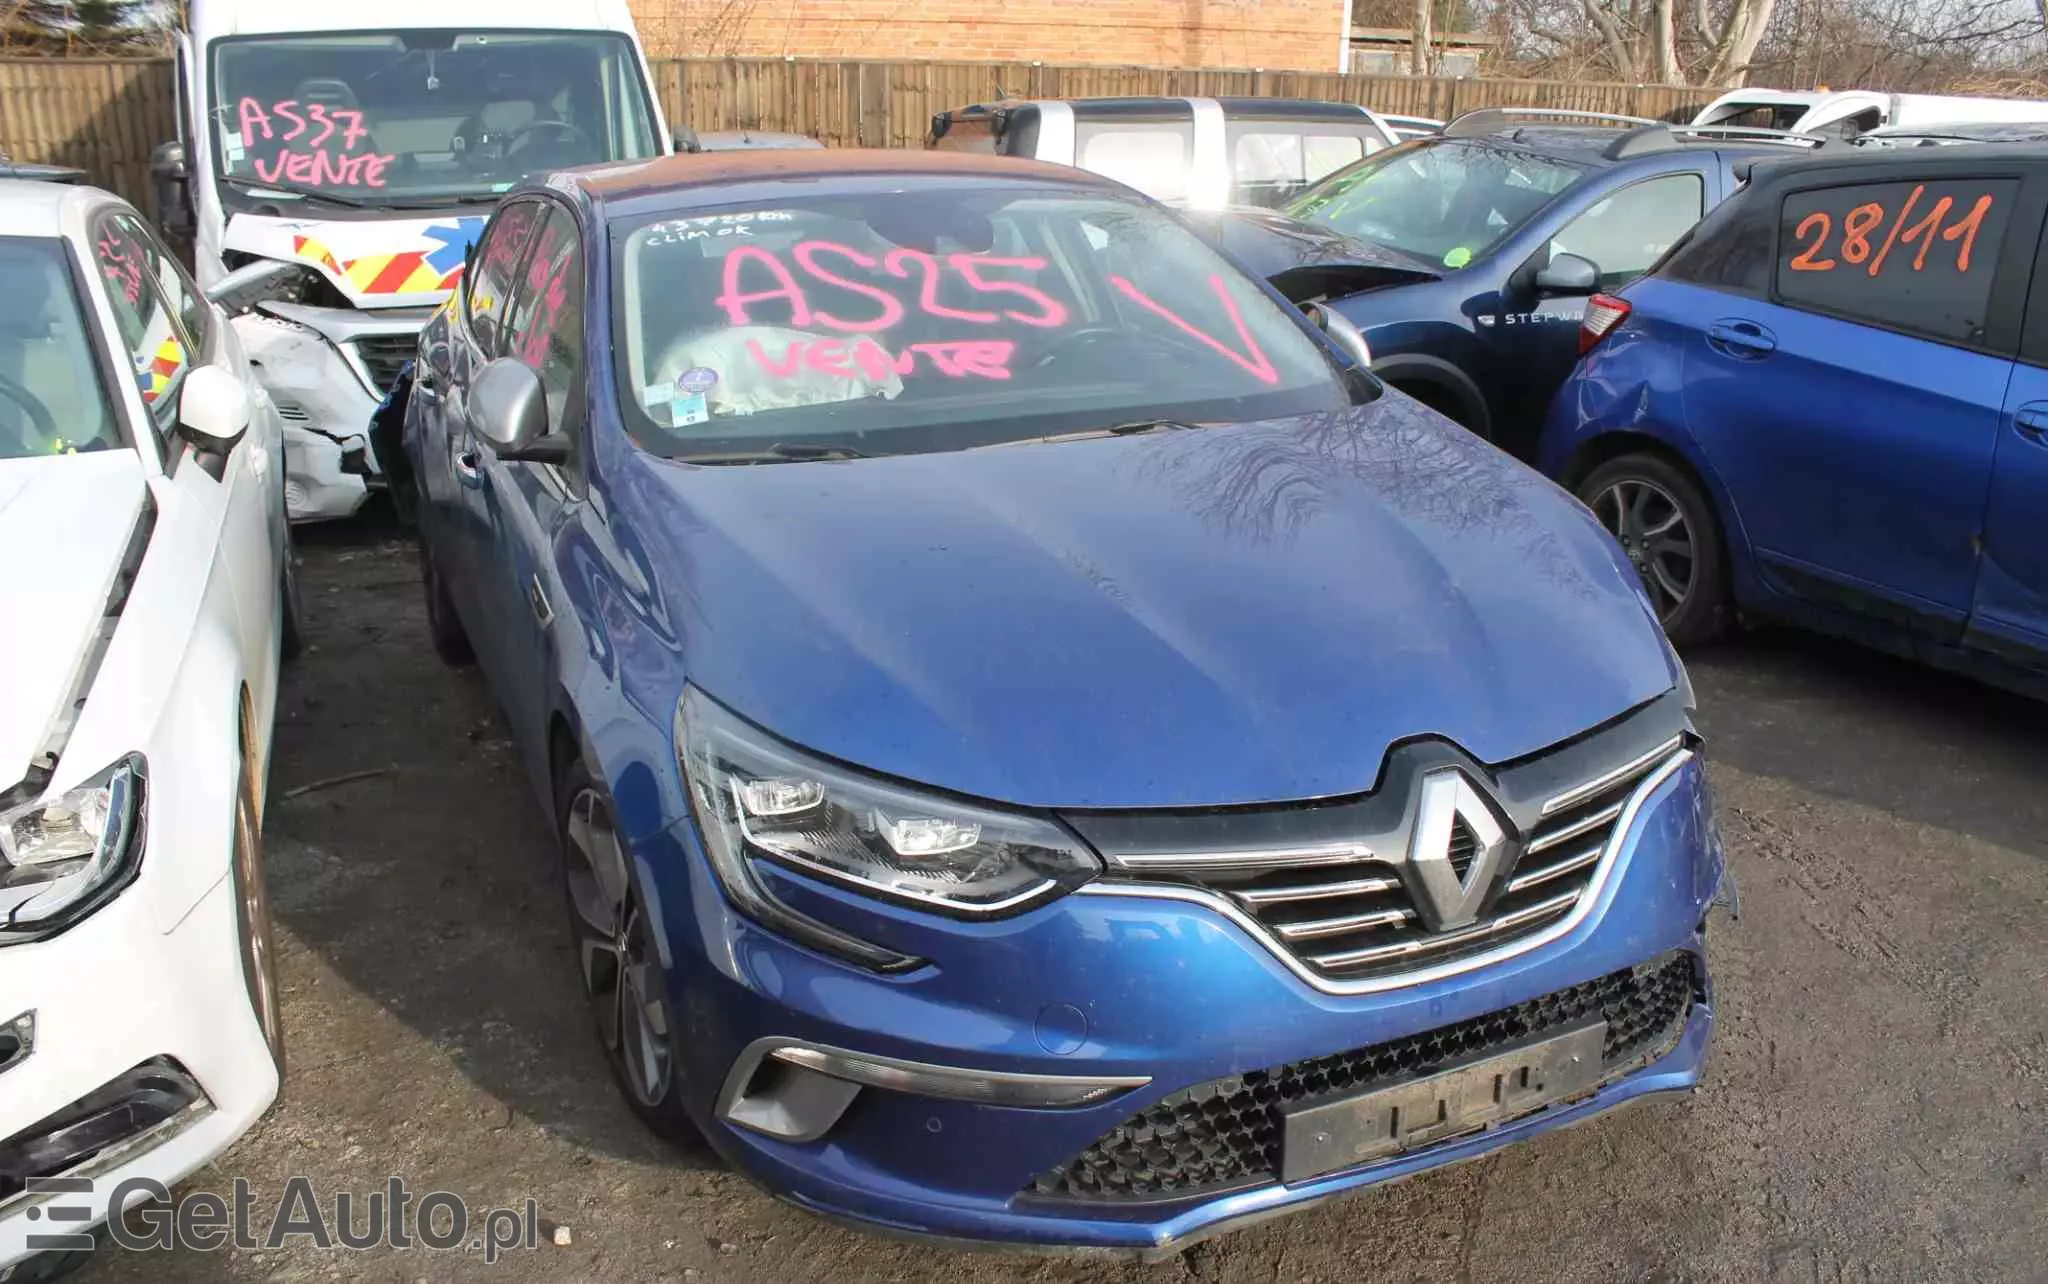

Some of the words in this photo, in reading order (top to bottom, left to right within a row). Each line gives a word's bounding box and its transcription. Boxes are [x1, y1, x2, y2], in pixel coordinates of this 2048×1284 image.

[239, 96, 366, 149] AS37
[254, 149, 395, 187] VENTE
[1789, 185, 1993, 275] 28/11
[717, 240, 1068, 332] AS25
